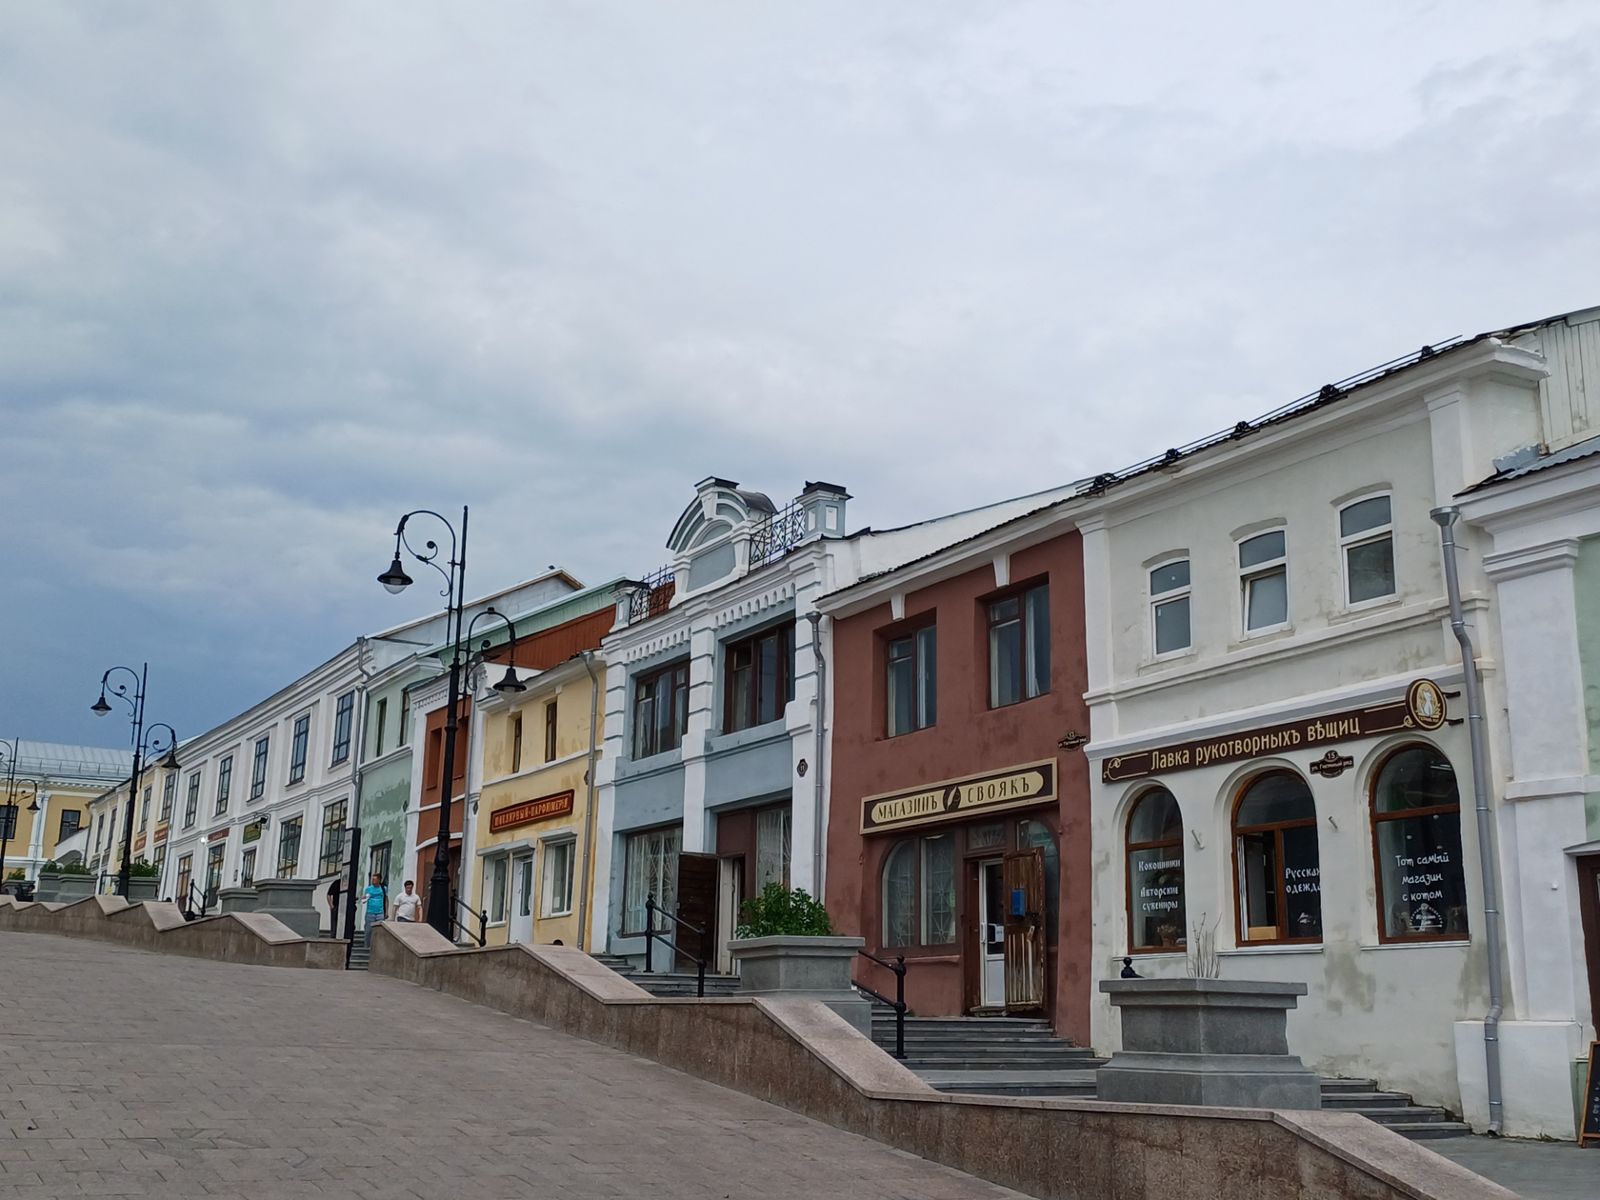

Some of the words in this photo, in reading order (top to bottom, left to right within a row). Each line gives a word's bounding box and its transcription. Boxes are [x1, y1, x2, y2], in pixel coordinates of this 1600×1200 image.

[1151, 748, 1190, 770] Лавка
[1195, 729, 1301, 767] рукотворныхъ
[1327, 751, 1336, 760] 15
[877, 795, 938, 820] МАГАЗИНЪ
[967, 777, 1030, 803] СВОЯКЪ
[1416, 851, 1450, 865] самый
[1401, 873, 1444, 886] магазин
[1410, 890, 1443, 901] котом
